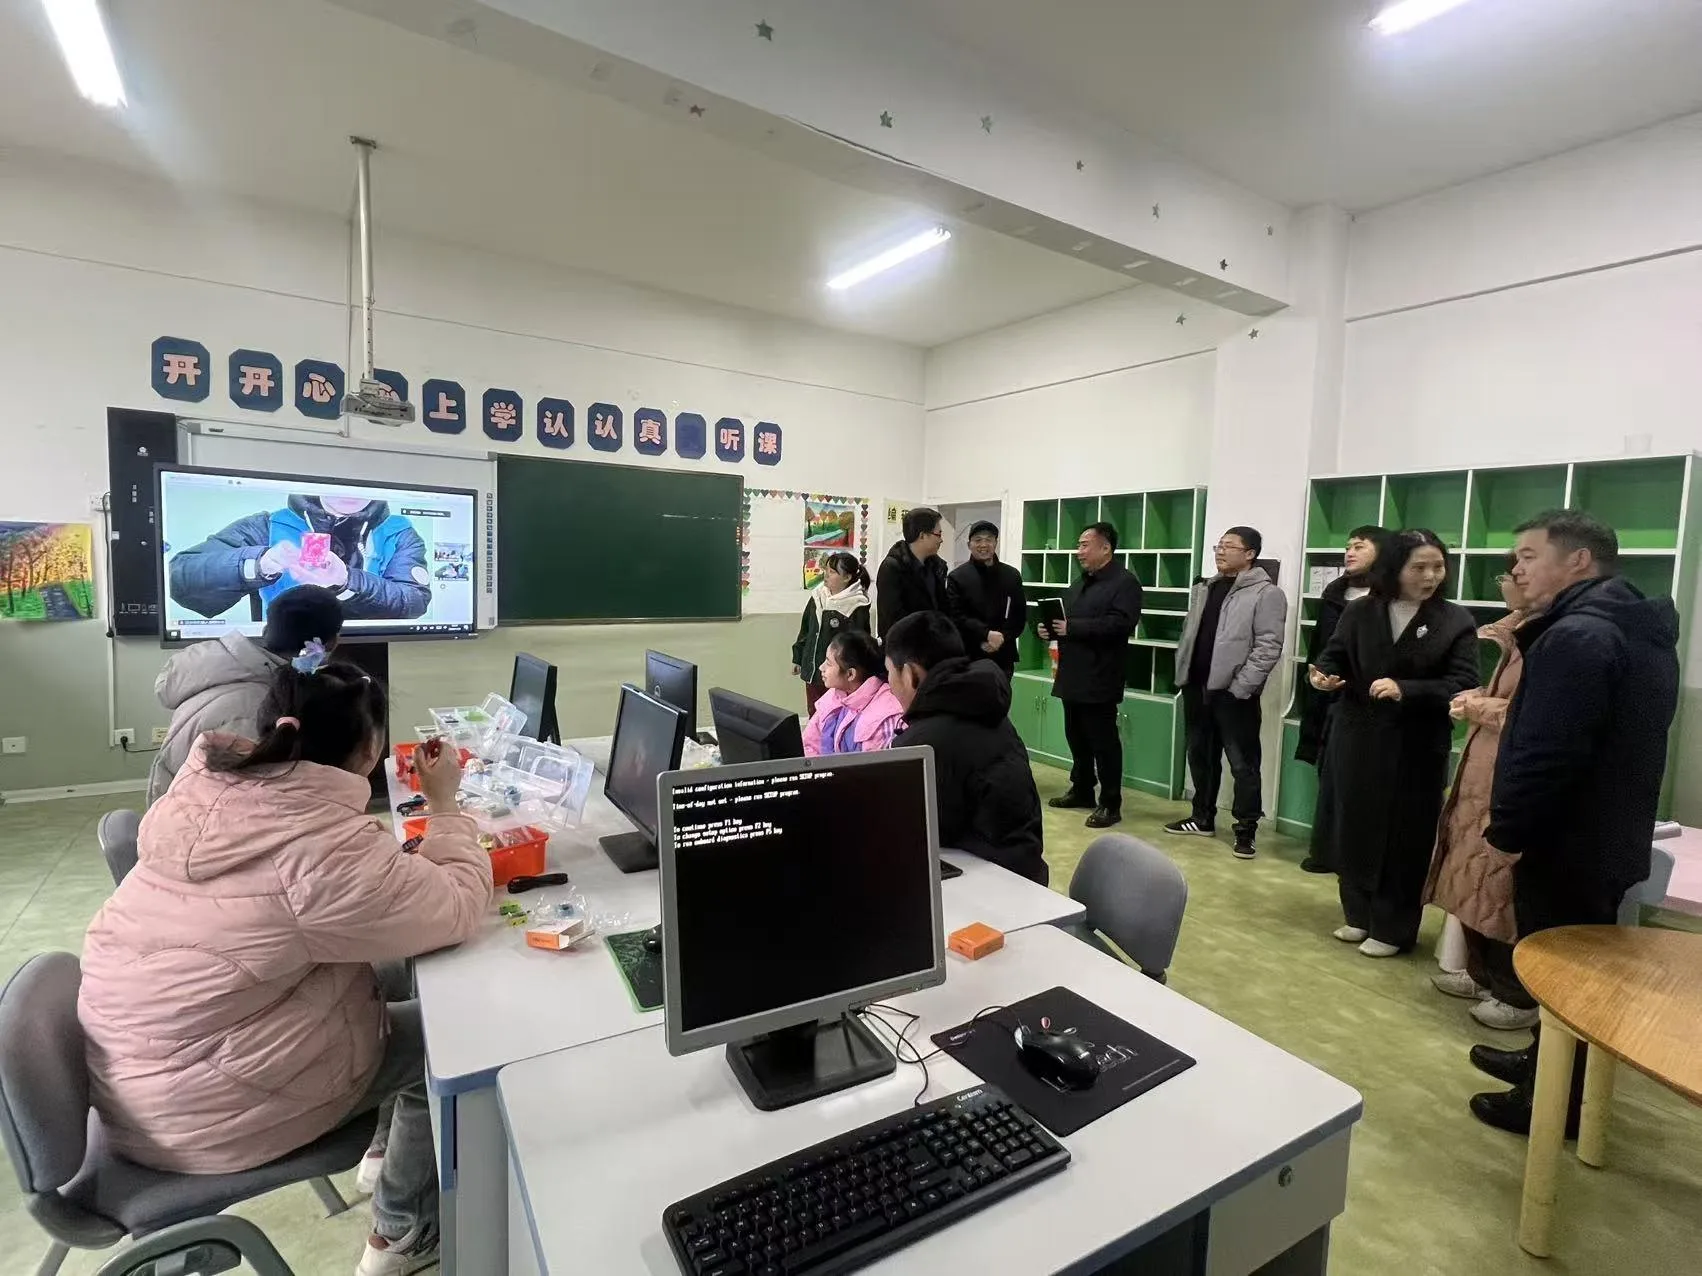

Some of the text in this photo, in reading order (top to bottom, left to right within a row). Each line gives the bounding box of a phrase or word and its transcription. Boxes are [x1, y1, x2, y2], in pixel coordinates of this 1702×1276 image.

[694, 782, 733, 792] configuration
[734, 778, 765, 788] information
[771, 776, 788, 784] please
[734, 795, 752, 803] please
